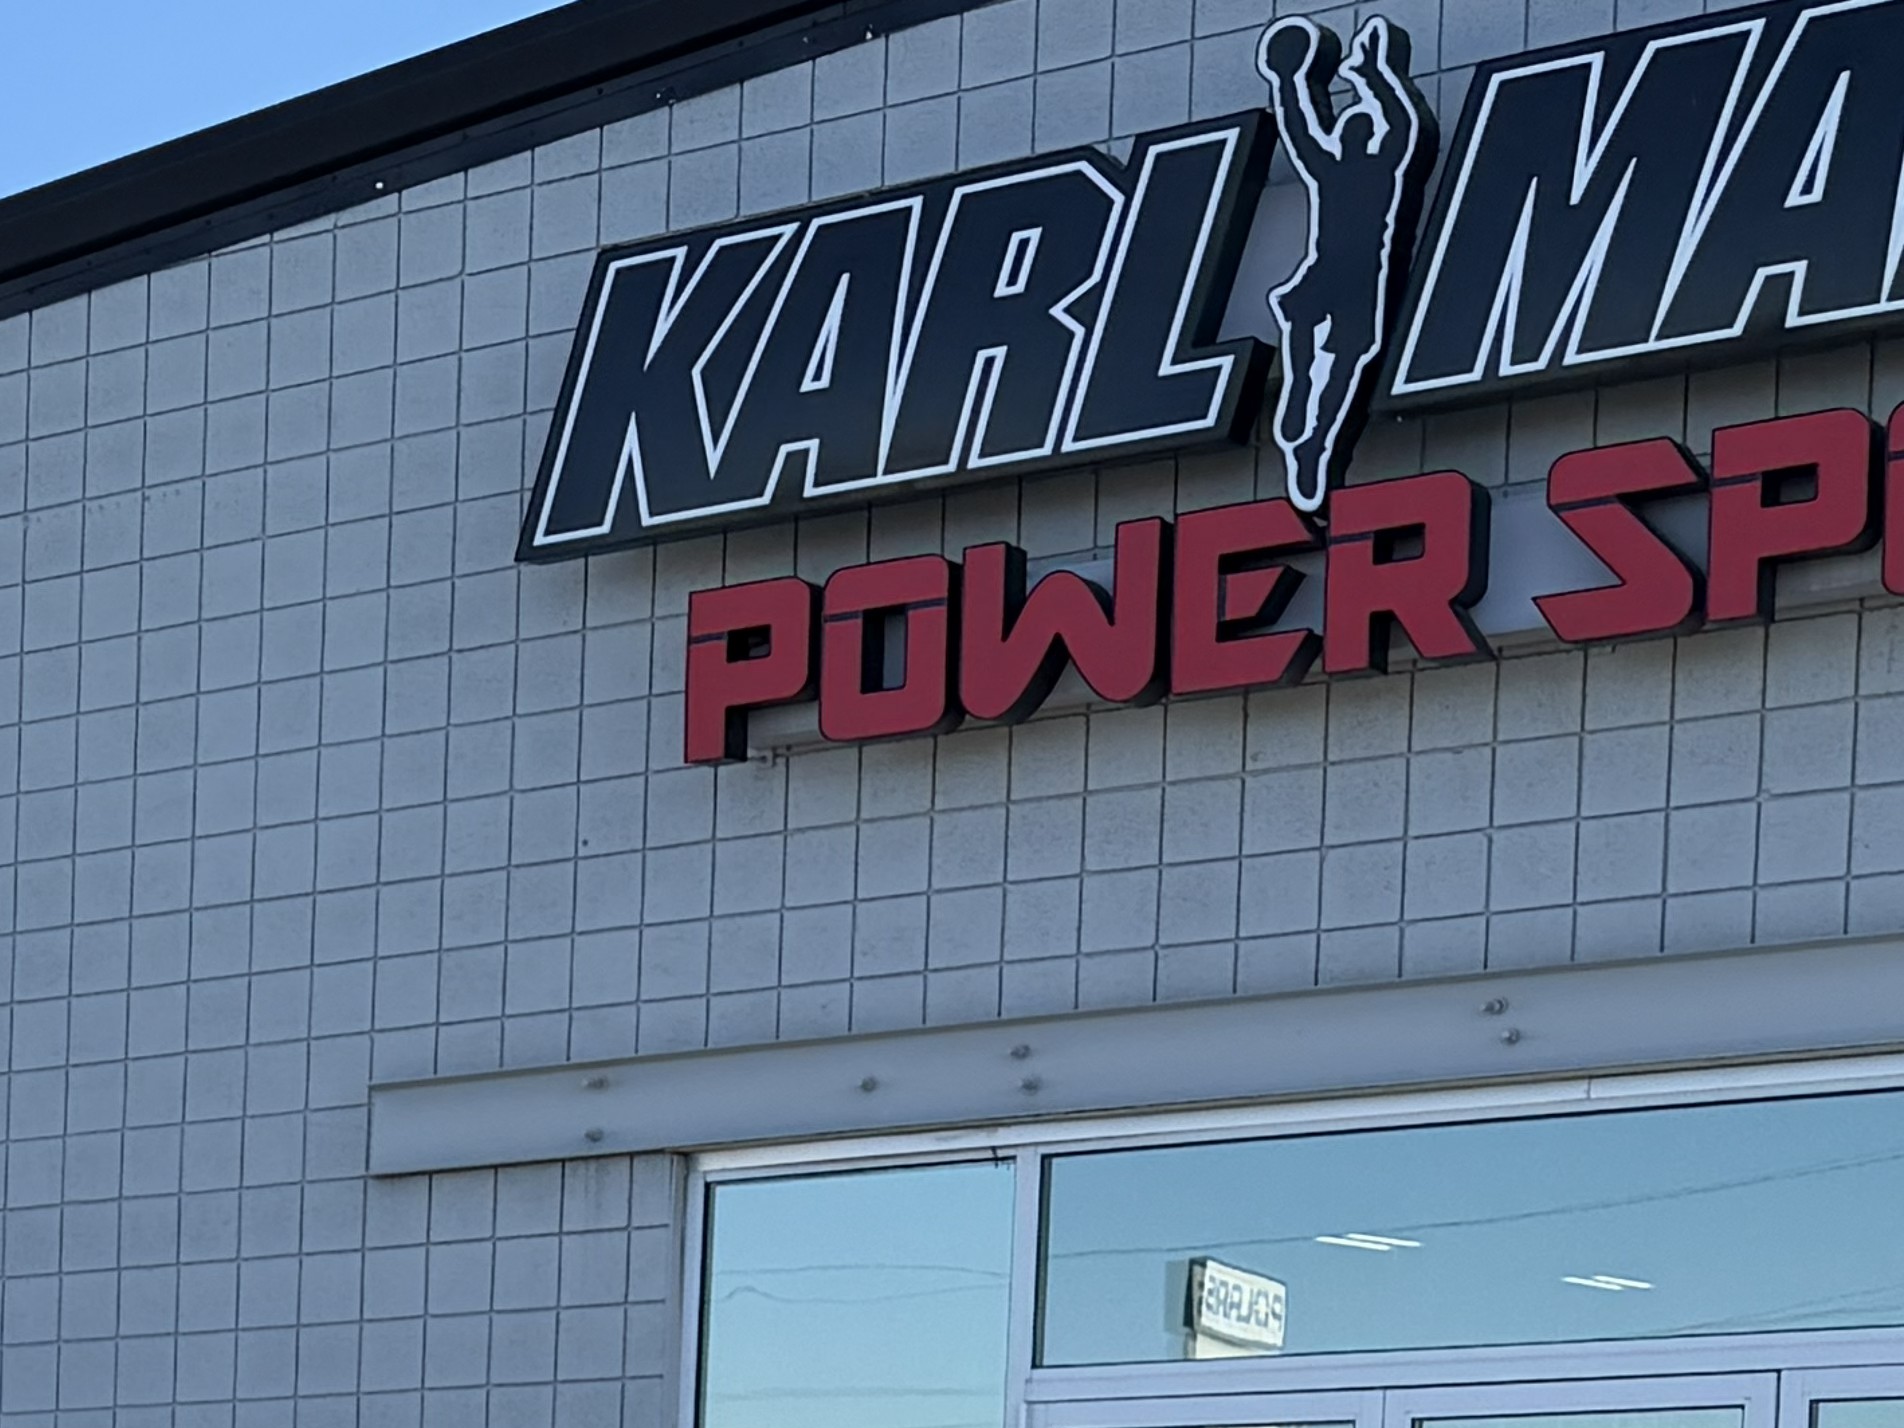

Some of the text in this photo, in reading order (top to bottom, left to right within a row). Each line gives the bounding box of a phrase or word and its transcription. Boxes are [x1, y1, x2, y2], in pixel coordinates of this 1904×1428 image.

[527, 0, 1904, 556] KARL MA
[683, 400, 1904, 765] POWER SP
